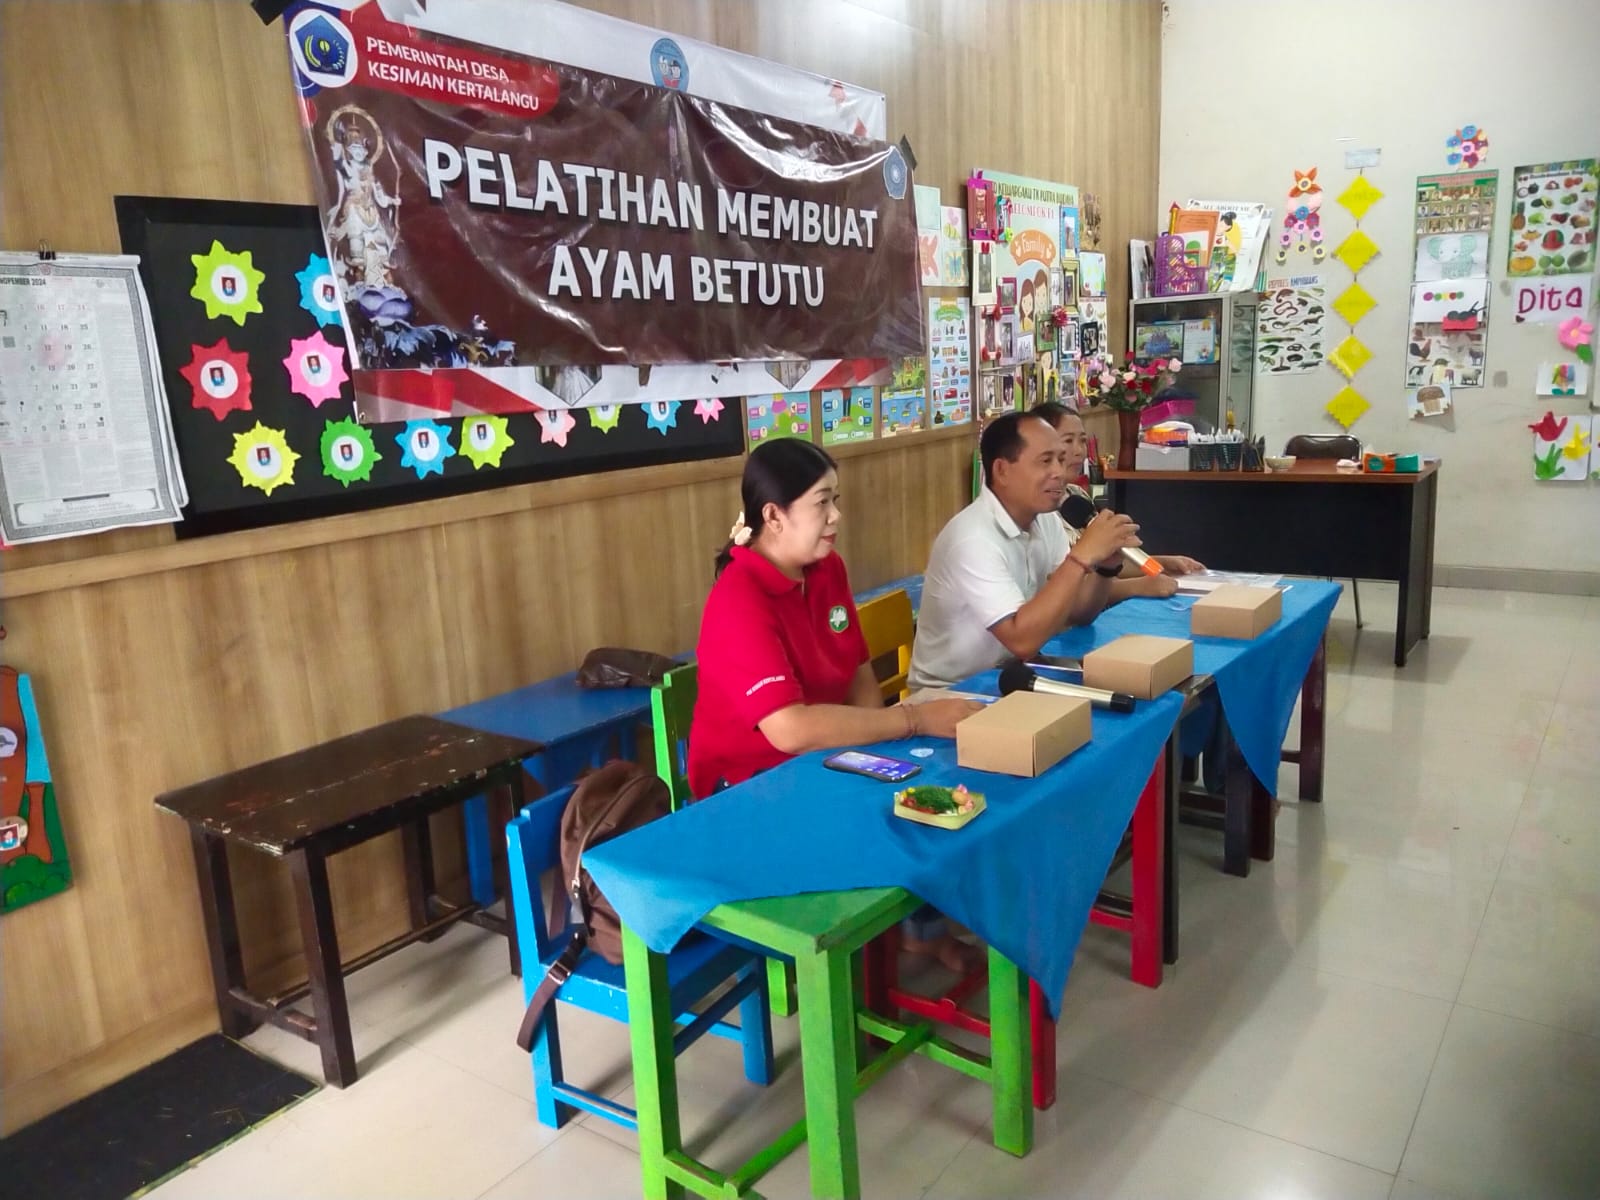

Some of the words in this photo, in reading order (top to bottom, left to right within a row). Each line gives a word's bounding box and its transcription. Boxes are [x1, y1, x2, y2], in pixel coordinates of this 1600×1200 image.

[366, 36, 469, 74] PEMERINTAH
[472, 61, 509, 83] DESA
[367, 61, 444, 91] KESIMAN
[447, 78, 539, 111] KERTALANGU
[424, 138, 704, 231] PELATIHAN
[717, 188, 878, 249] MEMBUAT
[548, 245, 674, 301] AYAM
[690, 256, 824, 307] BETUTU
[1518, 284, 1583, 314] Dita
